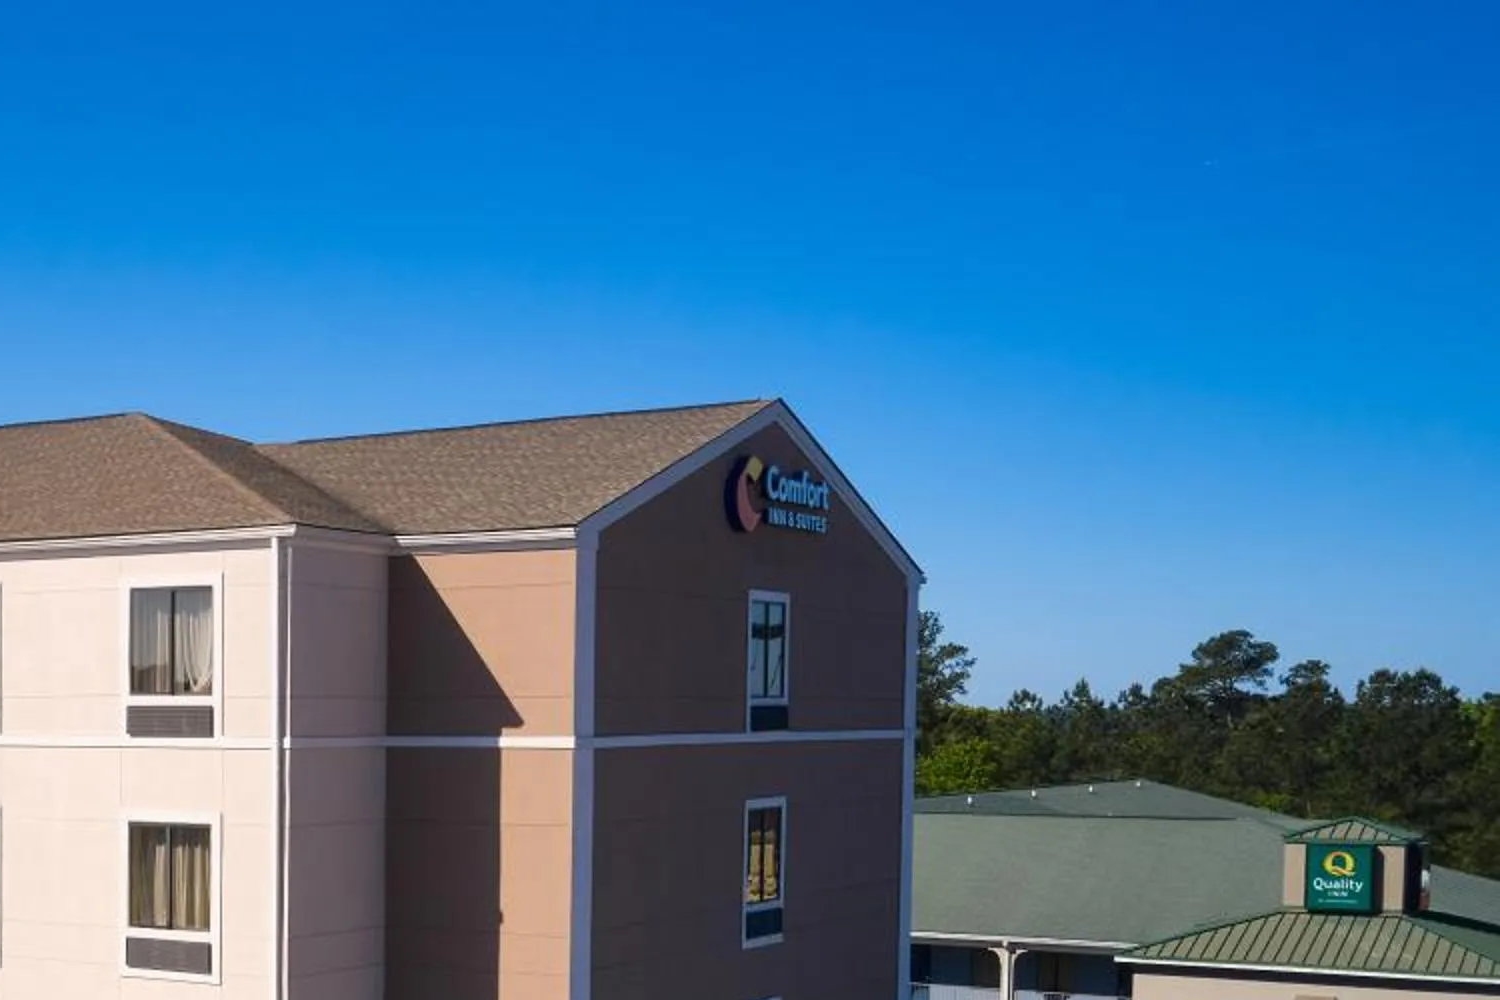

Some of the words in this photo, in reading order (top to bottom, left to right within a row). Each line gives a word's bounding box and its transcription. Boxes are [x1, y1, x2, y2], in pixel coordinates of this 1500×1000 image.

[767, 465, 829, 511] Comfort
[768, 507, 787, 525] INN
[795, 513, 828, 535] SUITES
[1322, 851, 1356, 877] Q
[1313, 877, 1363, 892] Quality
